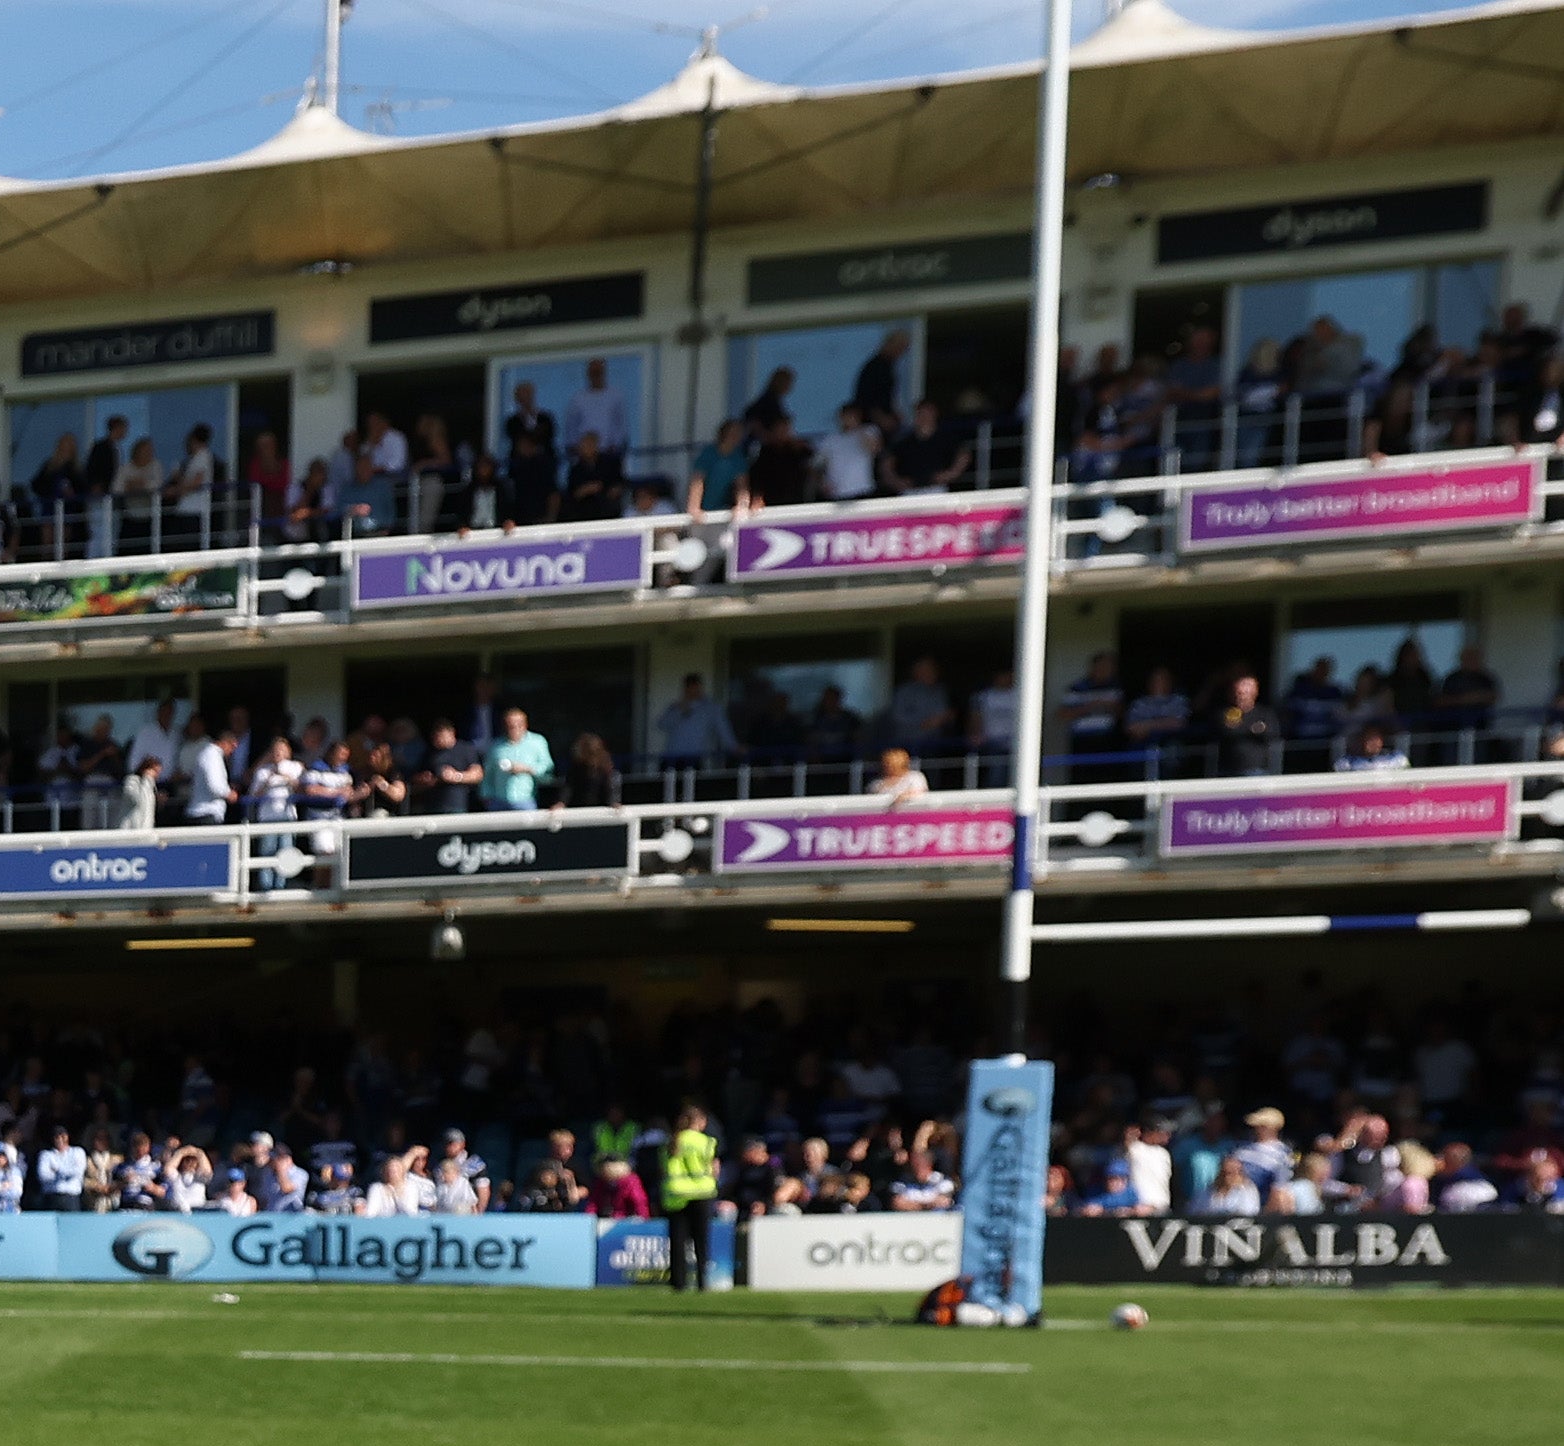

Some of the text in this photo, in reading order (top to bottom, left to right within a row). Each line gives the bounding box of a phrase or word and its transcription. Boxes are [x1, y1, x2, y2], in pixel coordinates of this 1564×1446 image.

[405, 554, 586, 594] Novuna
[438, 838, 536, 874] dyson
[796, 820, 1016, 858] TRUESPEED
[50, 852, 147, 885] ontrac
[231, 1224, 535, 1282] Gallagher
[810, 1236, 950, 1266] ontrac
